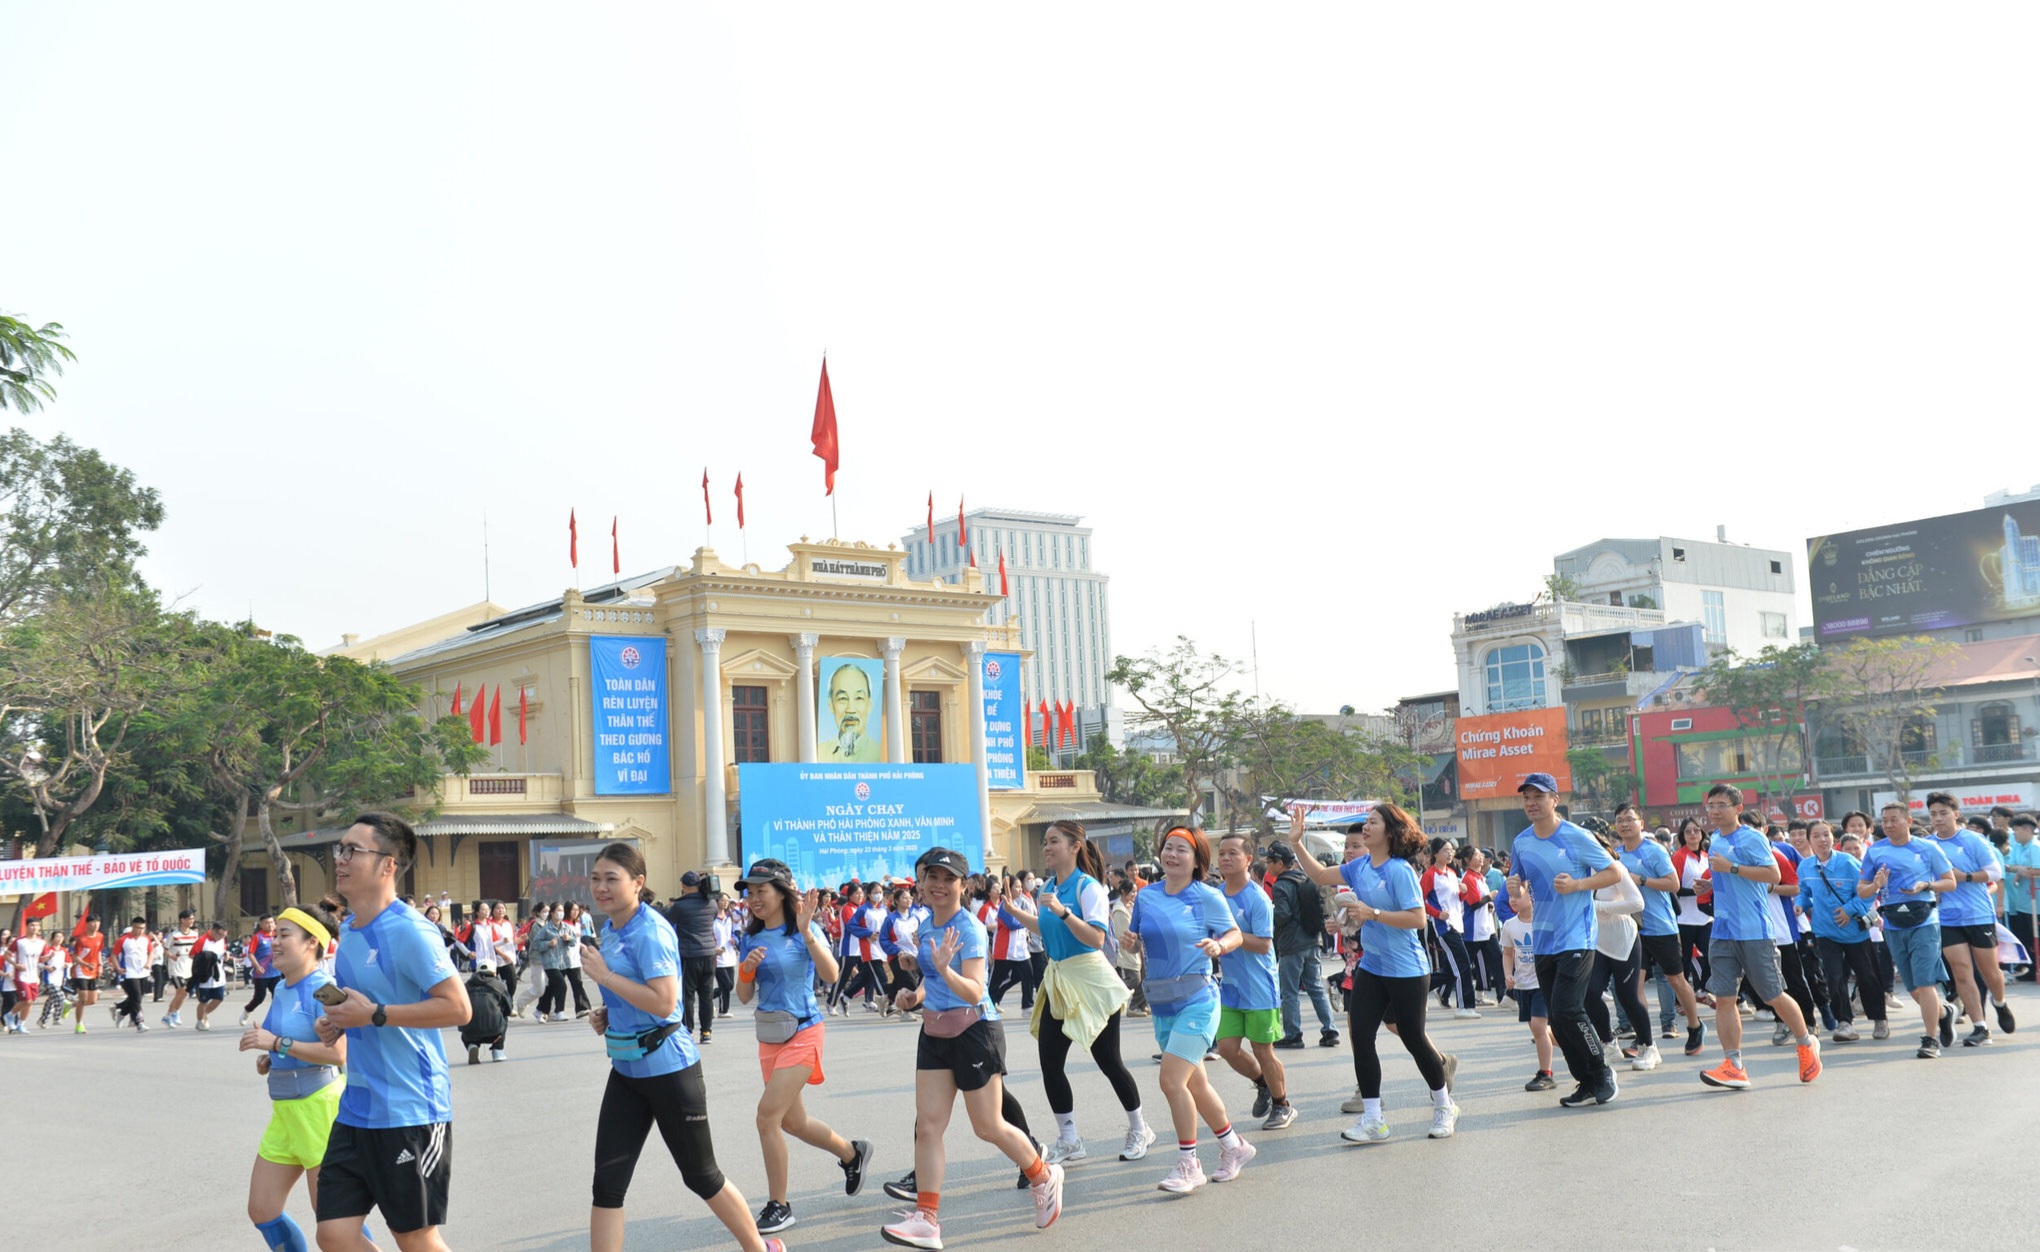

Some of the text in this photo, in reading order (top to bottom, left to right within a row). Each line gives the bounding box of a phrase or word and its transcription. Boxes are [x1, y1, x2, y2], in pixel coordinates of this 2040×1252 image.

[605, 677, 656, 691] TOÀN DÂN
[603, 695, 658, 712] RÈN LUYỆN
[607, 713, 632, 727] THÂN
[600, 733, 662, 746] THEO GƯƠNG
[1461, 723, 1544, 744] Chứng Khoán
[613, 750, 634, 764] BÁC
[1462, 747, 1496, 760] Mirae
[1499, 743, 1534, 757] Asset
[631, 769, 647, 784] ĐẠI
[994, 766, 1016, 779] THIỆN
[825, 802, 904, 817] NGÀY CHẠY
[773, 815, 954, 831] VÌ THÀNH PHỐ HẢI PHÒNG XANH, VĂN MINH
[813, 829, 921, 844] VÀ THÂN THIỆN NĂM 2025
[0, 865, 35, 882] LUYỆN
[39, 863, 68, 878] THÂN
[72, 859, 93, 876] THỂ
[103, 858, 126, 874] BẢO
[129, 859, 142, 875] VỆ
[146, 855, 159, 872] TỔ
[162, 855, 191, 872] QUỐC
